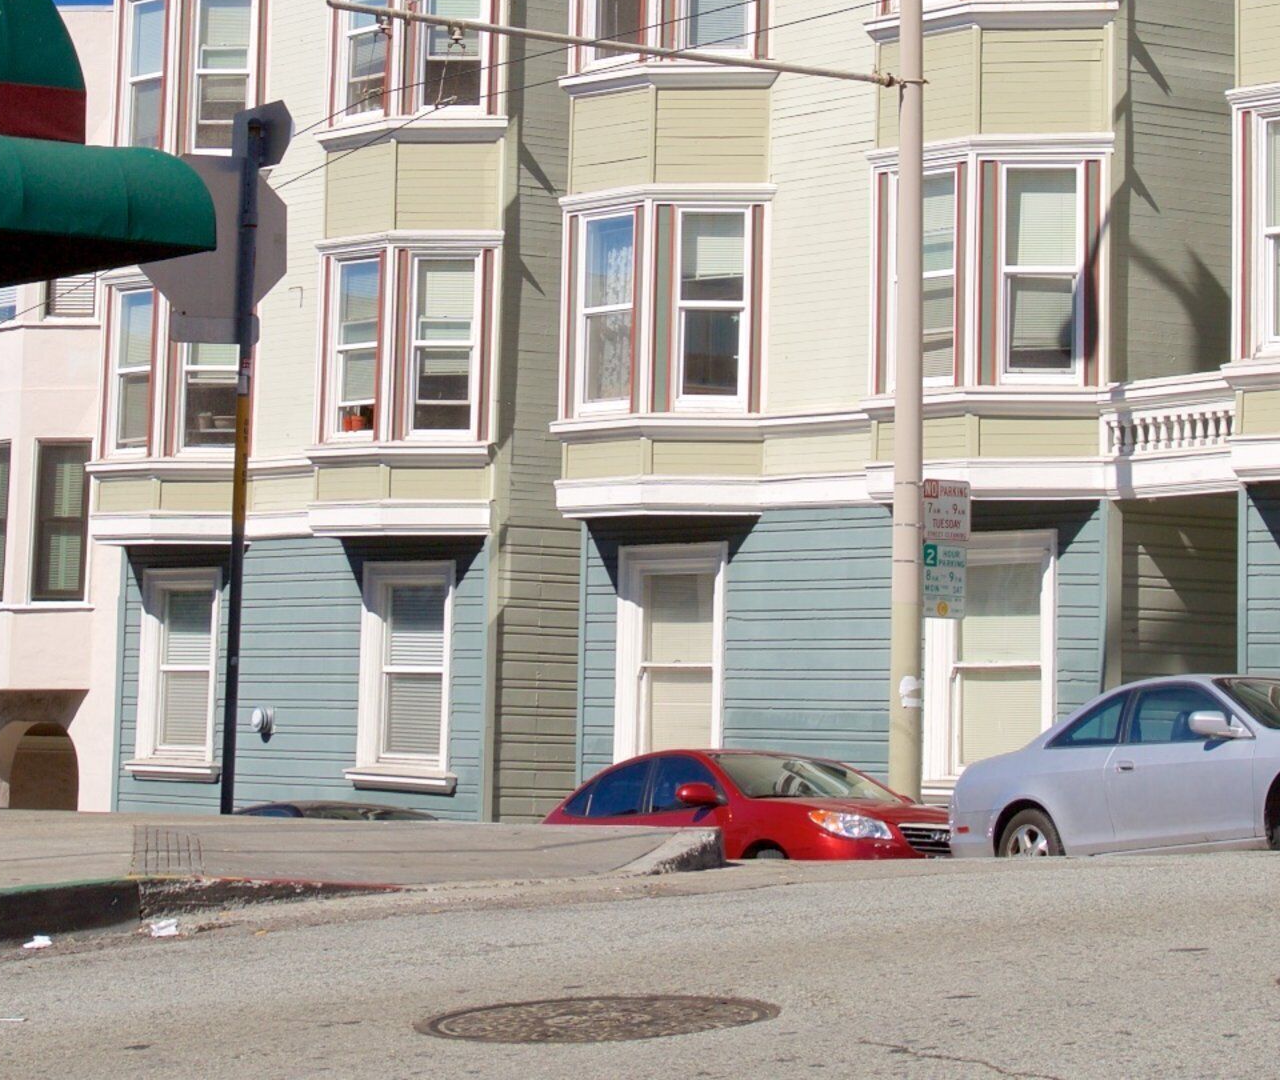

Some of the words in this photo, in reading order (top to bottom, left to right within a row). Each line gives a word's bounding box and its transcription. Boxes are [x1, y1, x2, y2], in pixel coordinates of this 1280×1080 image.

[924, 480, 938, 497] NO
[939, 485, 968, 498] PARKING
[932, 518, 962, 530] TUESDAY
[925, 548, 936, 565] 2
[942, 550, 961, 559] HOUR
[938, 559, 966, 569] PARKING
[924, 583, 940, 593] MON
[952, 585, 964, 594] SAT
